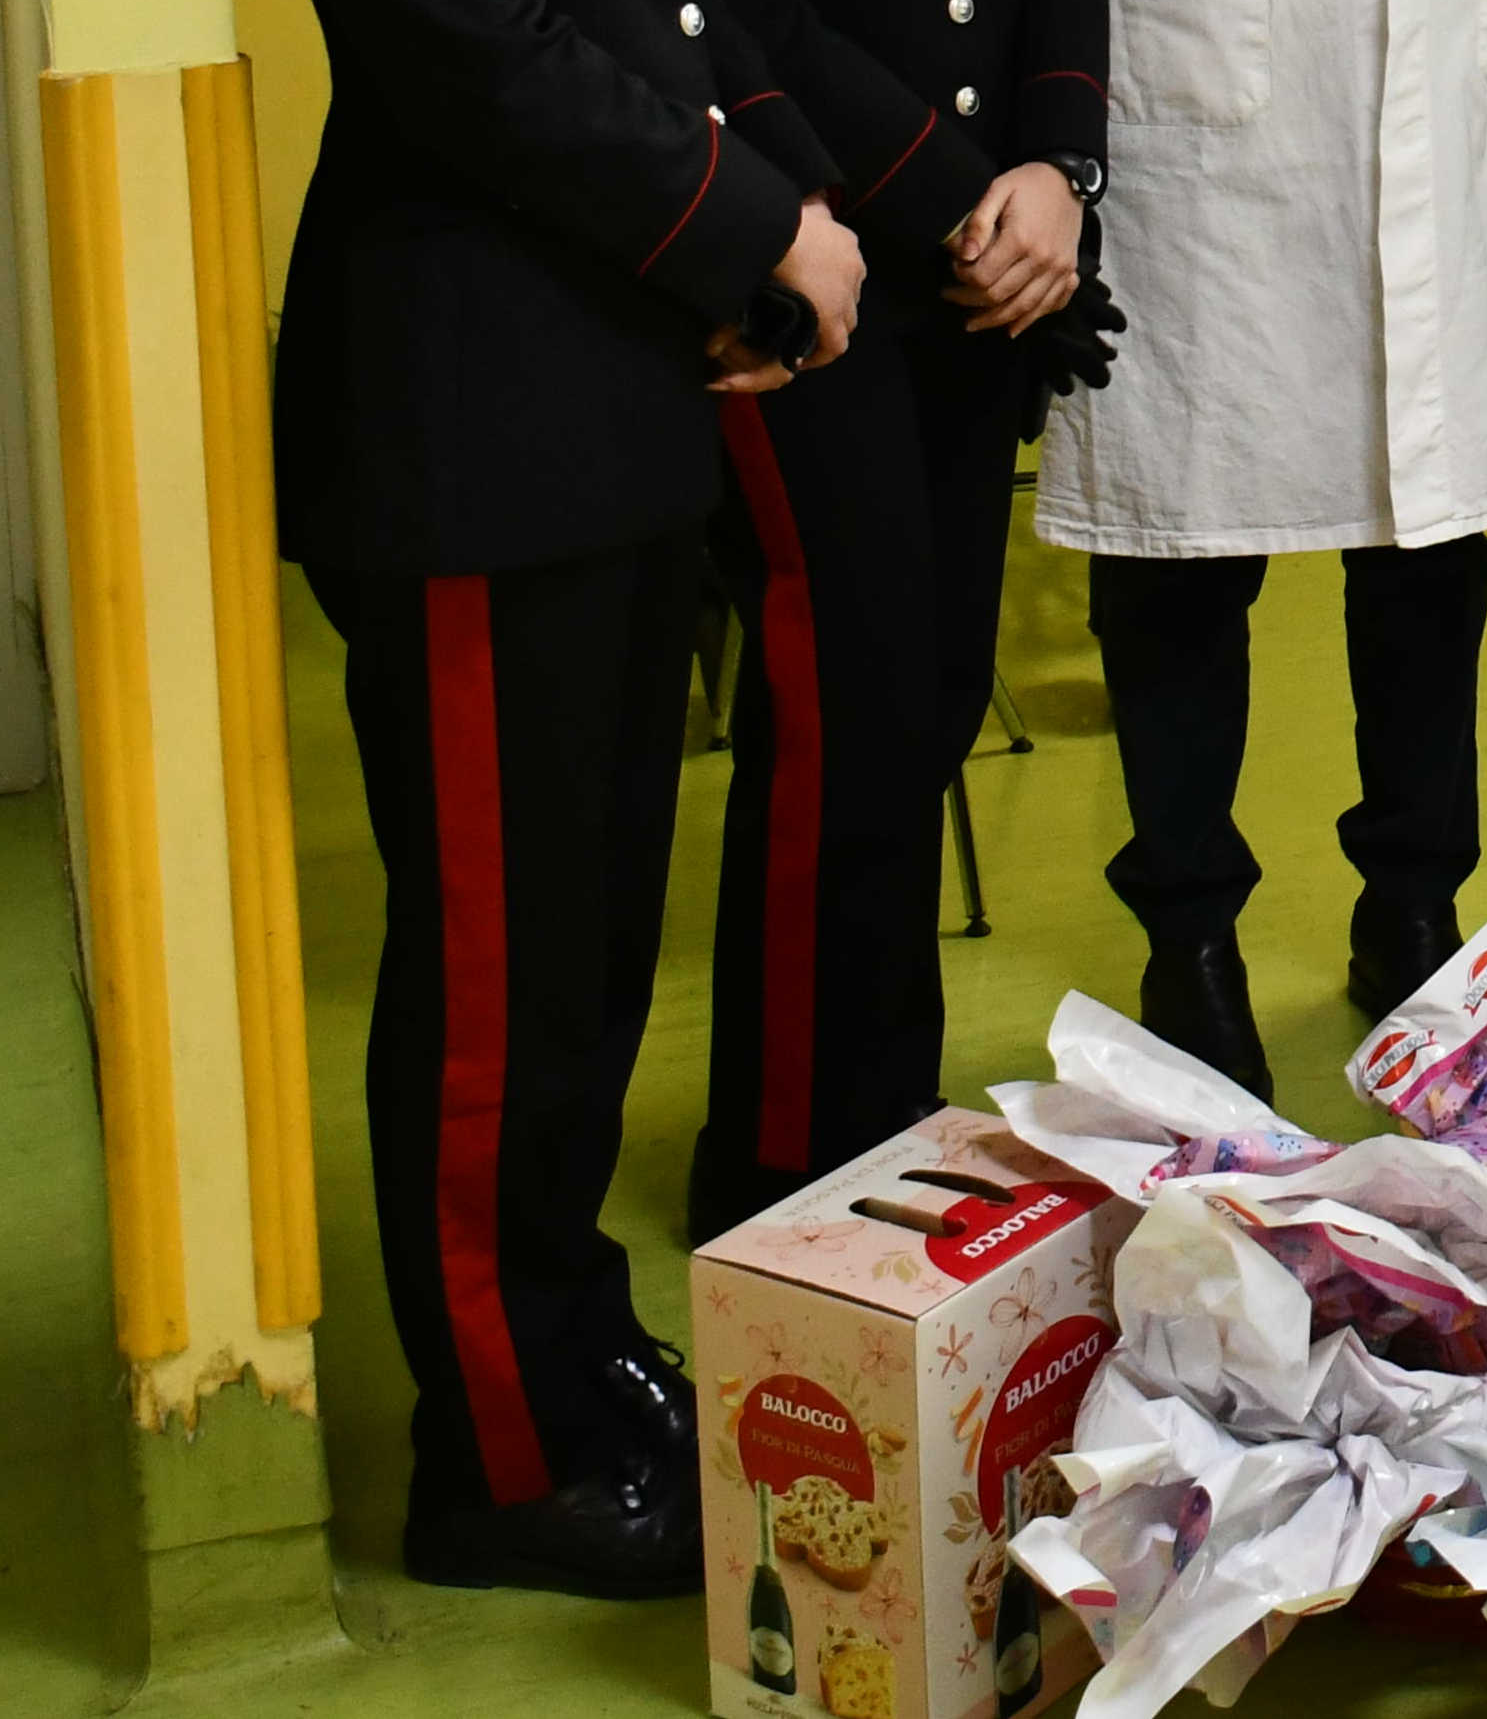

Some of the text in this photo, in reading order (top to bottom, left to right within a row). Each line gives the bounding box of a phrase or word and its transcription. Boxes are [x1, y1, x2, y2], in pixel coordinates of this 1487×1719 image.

[961, 1192, 1069, 1259] BALOCCO
[1004, 1331, 1101, 1414] BALOCCO
[761, 1392, 849, 1435] BALOCCO
